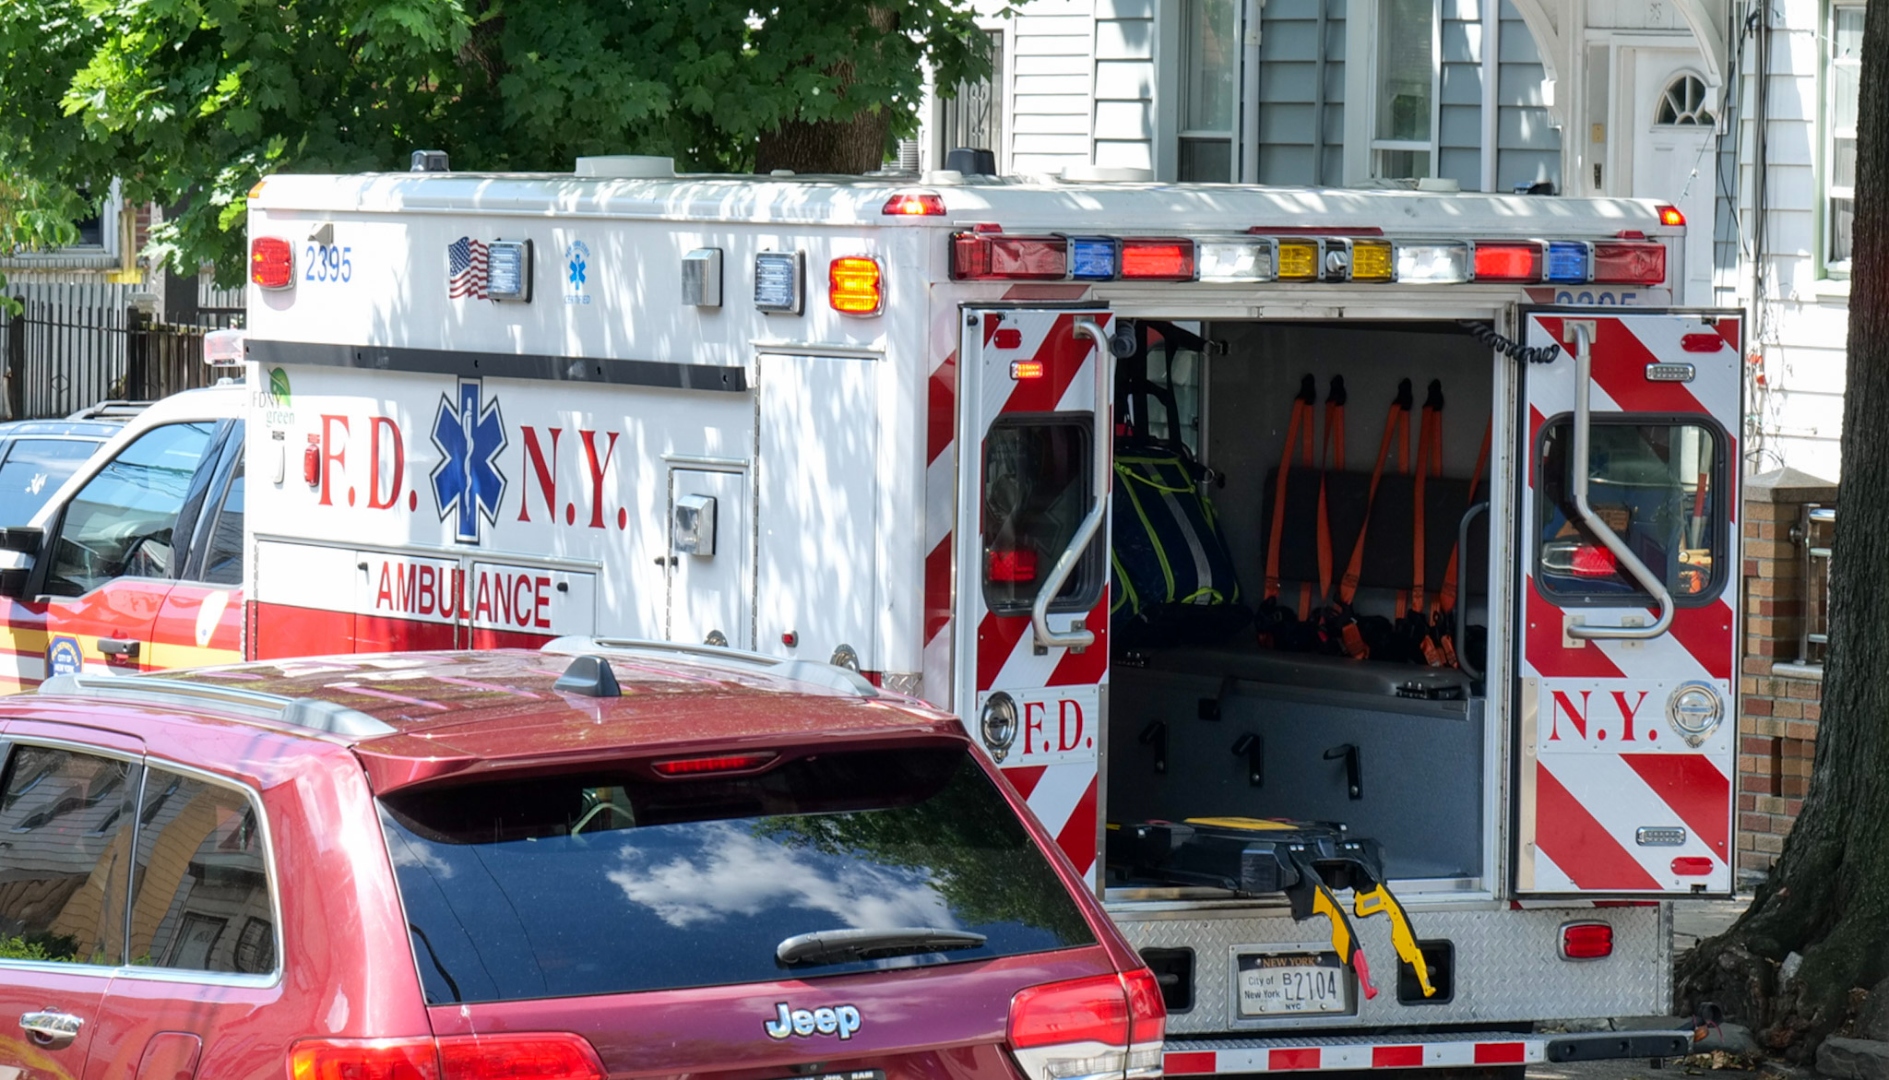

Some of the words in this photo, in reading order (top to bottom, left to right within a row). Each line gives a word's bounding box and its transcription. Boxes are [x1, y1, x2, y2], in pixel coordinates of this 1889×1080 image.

[305, 245, 352, 283] 2395
[252, 390, 281, 409] FDNY
[266, 410, 295, 428] green
[376, 560, 552, 630] AMBULANCE
[1022, 699, 1093, 755] F.D.
[1548, 690, 1658, 742] N.Y.
[1263, 957, 1287, 968] NEW
[1290, 956, 1316, 967] YORK
[1244, 990, 1262, 1000] New
[1263, 989, 1281, 999] York
[1248, 977, 1264, 987] City
[1266, 976, 1274, 985] of
[763, 1001, 862, 1041] Jeep
